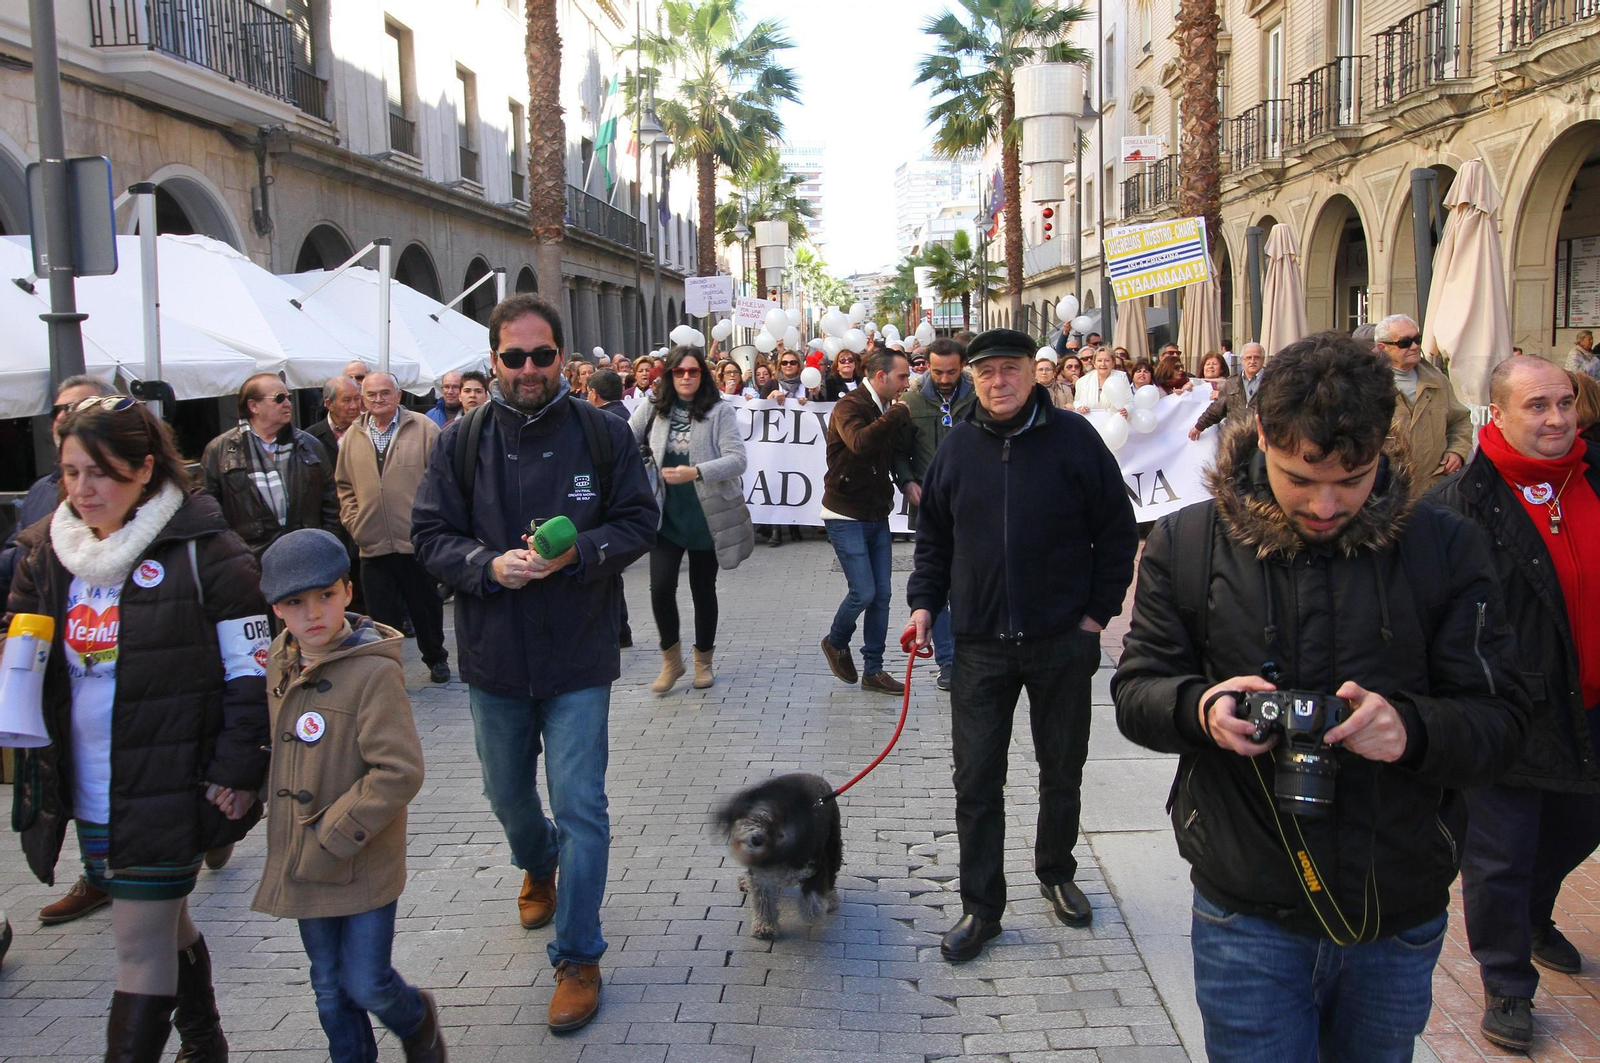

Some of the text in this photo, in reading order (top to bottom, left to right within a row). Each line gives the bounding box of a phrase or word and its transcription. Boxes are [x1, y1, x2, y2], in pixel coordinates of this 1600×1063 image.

[1107, 220, 1197, 256] QUEREMOS NUESTRO CHARE
[1128, 252, 1179, 272] ISLA CRISTINA
[741, 469, 813, 507] AD
[68, 618, 120, 642] Yeah!!
[1297, 850, 1322, 893] Nikon
